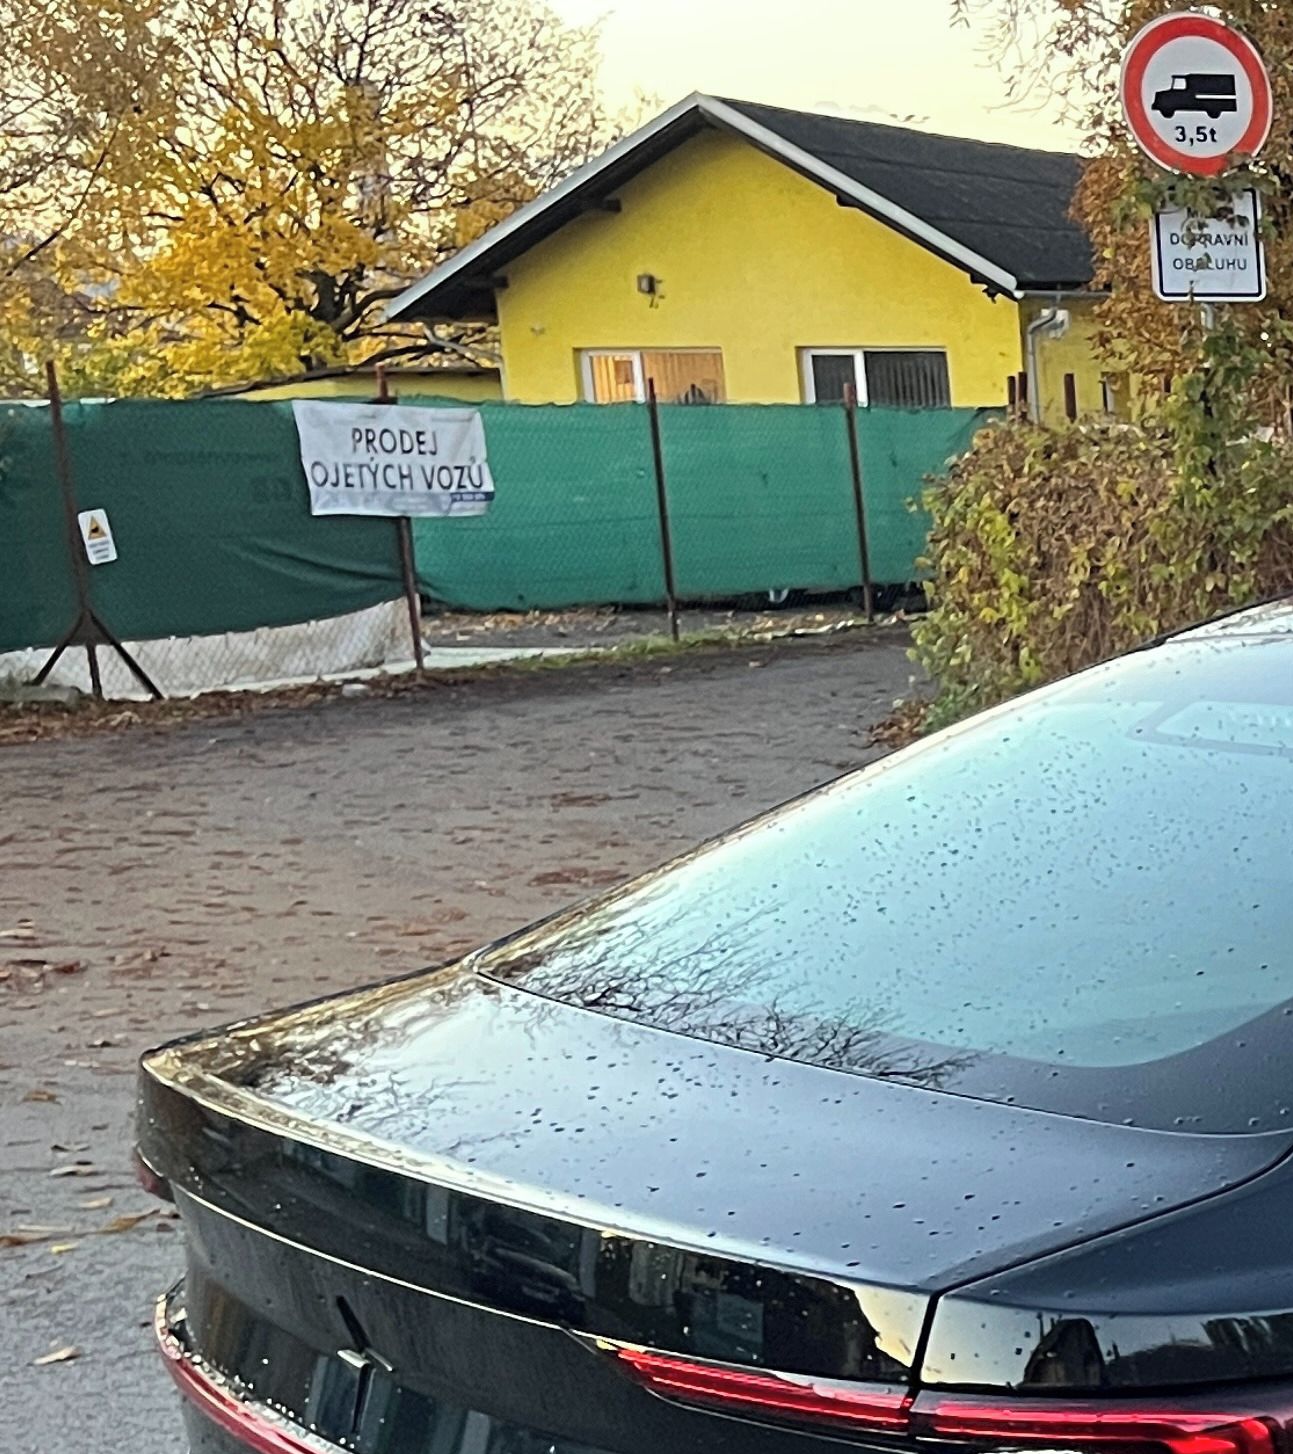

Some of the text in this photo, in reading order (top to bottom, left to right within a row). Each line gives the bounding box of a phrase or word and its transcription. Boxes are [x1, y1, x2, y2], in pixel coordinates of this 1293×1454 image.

[1175, 125, 1218, 147] 3,5t
[1170, 231, 1249, 246] DORAVNÍ
[1173, 257, 1247, 270] OBLUHU
[352, 428, 438, 456] PRODEJ
[311, 456, 414, 490] OJETÝCH
[421, 456, 483, 490] VOZŮ
